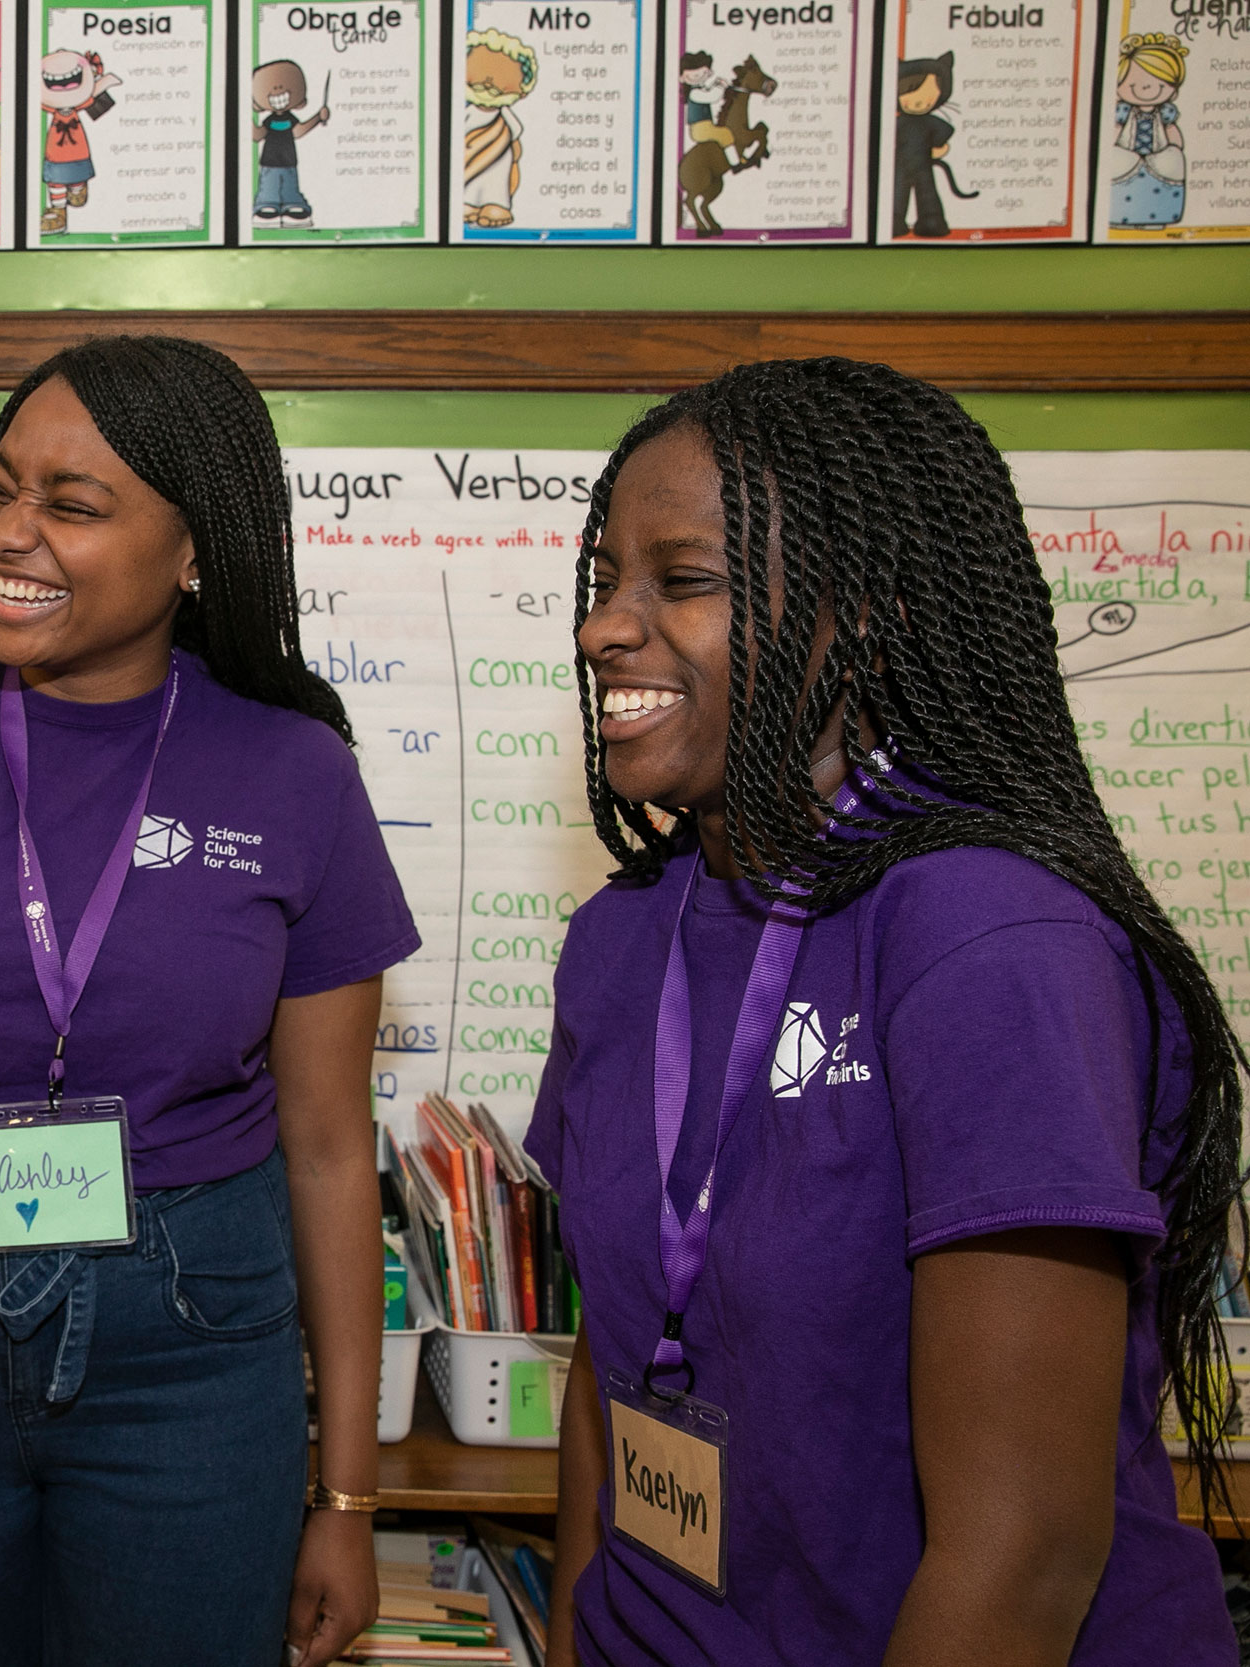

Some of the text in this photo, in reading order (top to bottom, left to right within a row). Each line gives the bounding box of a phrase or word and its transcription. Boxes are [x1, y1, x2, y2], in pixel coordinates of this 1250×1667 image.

[288, 6, 401, 33] Obra de
[529, 7, 591, 30] Mito
[713, 1, 833, 29] Leyenda
[949, 4, 1043, 29] Fábula
[1174, 9, 1200, 41] de
[330, 24, 388, 52] teatro
[972, 35, 1063, 50] Relato breve,
[544, 41, 628, 58] Leyenda en
[997, 58, 1037, 70] cuyos
[564, 66, 607, 80] la que
[963, 78, 1069, 91] personajes son
[551, 90, 620, 104] aparecen
[969, 97, 1062, 111] animales que
[557, 111, 614, 128] dioses y
[962, 115, 1066, 131] pueden hablar.
[557, 135, 613, 152] diosas y
[968, 136, 1028, 148] Contiene
[551, 158, 617, 174] explica el
[967, 156, 1059, 172] moraleja que
[540, 181, 626, 199] origen de la
[970, 175, 1053, 190] nos enseña
[995, 197, 1023, 211] algo.
[560, 208, 602, 219] cosas
[435, 453, 592, 502] Verbos
[307, 525, 353, 545] Make
[363, 535, 373, 545] a
[381, 528, 421, 547] verb
[435, 535, 483, 554] agree
[496, 528, 533, 547] with
[544, 531, 564, 548] its
[1160, 511, 1191, 553] la
[1051, 565, 1218, 606] divertida,
[389, 729, 559, 757] -ar com
[1158, 800, 1217, 834] tus
[205, 825, 263, 846] Science
[204, 841, 238, 857] Club
[203, 855, 263, 875] for Girls
[622, 1437, 707, 1538] Kaelyn
